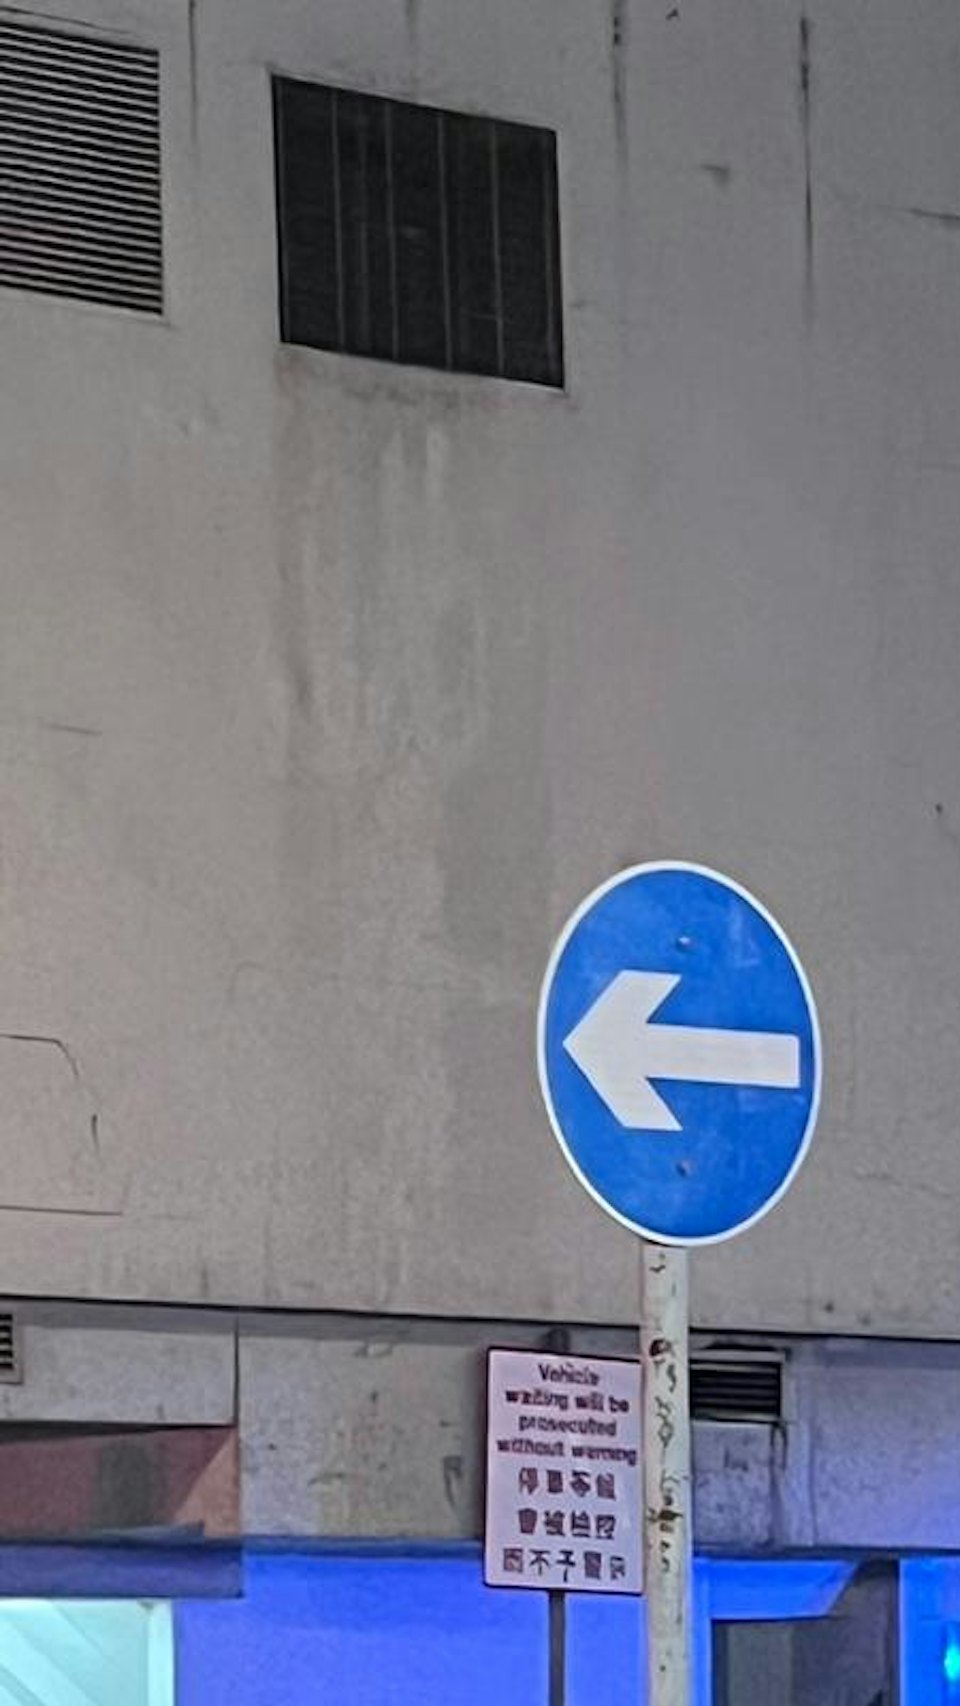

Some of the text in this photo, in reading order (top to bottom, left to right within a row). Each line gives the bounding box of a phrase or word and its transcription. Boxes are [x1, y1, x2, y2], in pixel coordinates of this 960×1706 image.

[537, 1362, 600, 1386] Vehicle
[505, 1388, 630, 1413] waiting will be
[518, 1415, 617, 1437] prosecuted
[496, 1437, 637, 1466] without warning
